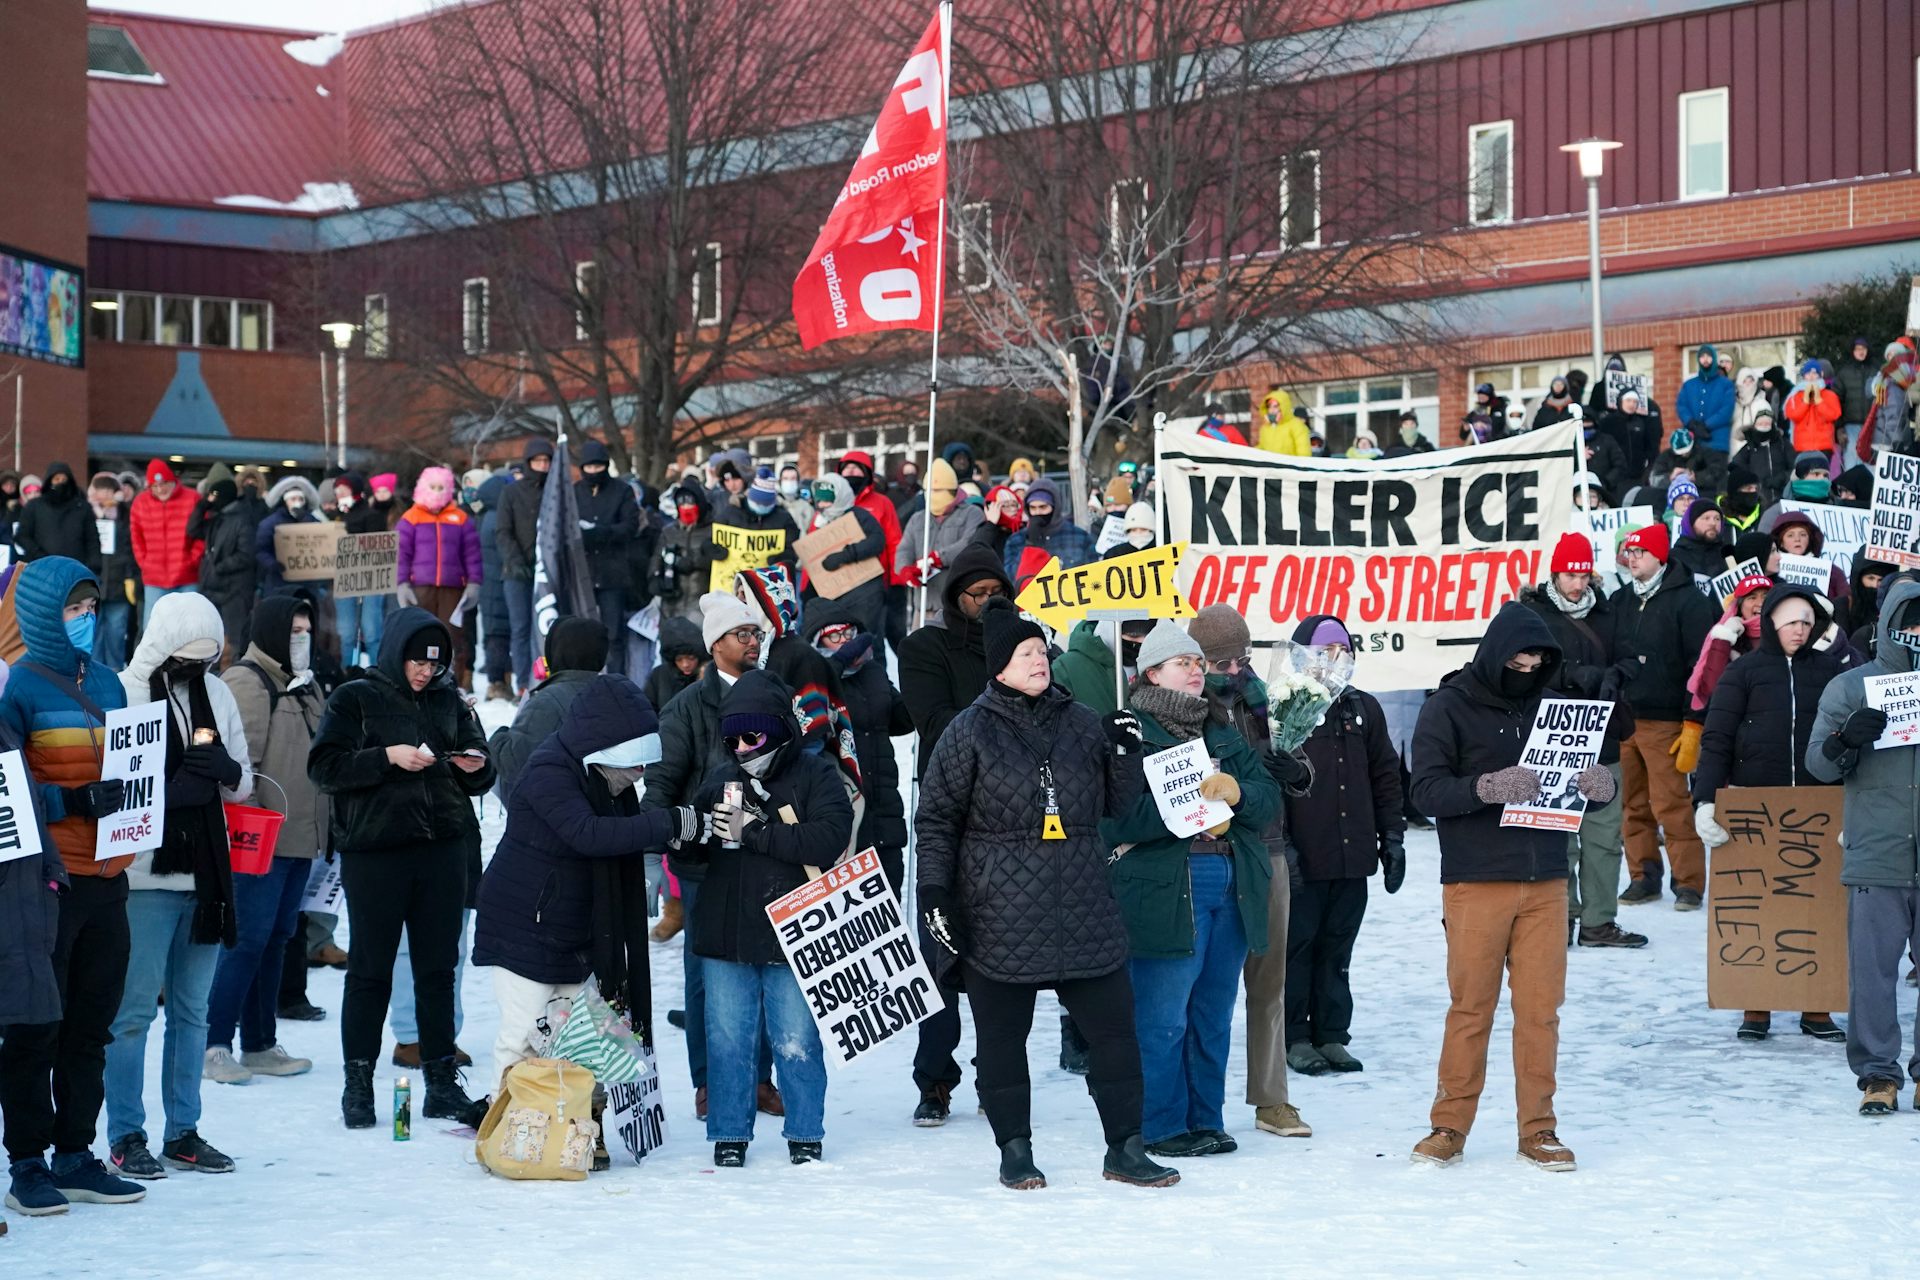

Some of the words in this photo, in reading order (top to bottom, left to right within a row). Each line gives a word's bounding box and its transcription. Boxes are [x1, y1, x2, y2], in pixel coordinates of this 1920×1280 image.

[820, 250, 849, 329] ganization
[1189, 475, 1418, 547] KILLER
[1440, 470, 1540, 546] ICE
[1876, 487, 1907, 508] ALEX
[1590, 510, 1628, 532] Will
[1852, 514, 1871, 543] NO
[1873, 508, 1913, 532] KILLED
[337, 535, 356, 553] KEEP
[746, 534, 782, 552] NOW.
[1870, 528, 1887, 547] BY
[1889, 532, 1908, 550] ICE
[287, 556, 319, 570] DEAD
[336, 553, 349, 570] OUT
[351, 552, 359, 568] OF
[360, 551, 370, 566] MY
[336, 570, 374, 592] ABOLISH
[376, 568, 392, 590] ICE
[1036, 570, 1091, 609] ICE
[1106, 560, 1165, 600] OUT
[1189, 555, 1269, 621] OFF
[1269, 554, 1356, 624] OUR
[1359, 550, 1542, 623] STREETS!
[1716, 562, 1761, 598] KILLER
[1350, 630, 1405, 652] RSO
[1875, 676, 1903, 686] JUSTICE
[1904, 674, 1920, 682] FOR
[1884, 685, 1914, 698] ALEX
[1536, 704, 1610, 732] JUSTICE
[110, 725, 132, 752] ICE
[136, 719, 162, 746] OUT
[1546, 734, 1589, 747] FOR
[130, 754, 142, 772] OF
[1153, 750, 1179, 765] JUSTICE
[1180, 744, 1196, 756] FOR
[1164, 757, 1194, 776] ALEX
[1524, 748, 1558, 767] ALEX
[1162, 770, 1205, 794] JEFFERY
[1170, 788, 1203, 808] PRETT
[1184, 808, 1210, 823] MIRAC
[1725, 802, 1774, 846] THE
[110, 824, 152, 843] MIRAC
[1772, 808, 1831, 898] SHOW
[842, 872, 888, 916] BY
[780, 902, 838, 946] ICE
[1714, 868, 1769, 967] FILES!
[792, 898, 902, 980] MURDERED
[873, 932, 917, 978] ALL
[1774, 928, 1818, 976] US
[806, 958, 879, 1020] THOSE
[852, 981, 890, 1010] FOR
[830, 976, 930, 1062] JUSTICE
[632, 1101, 645, 1118] OR
